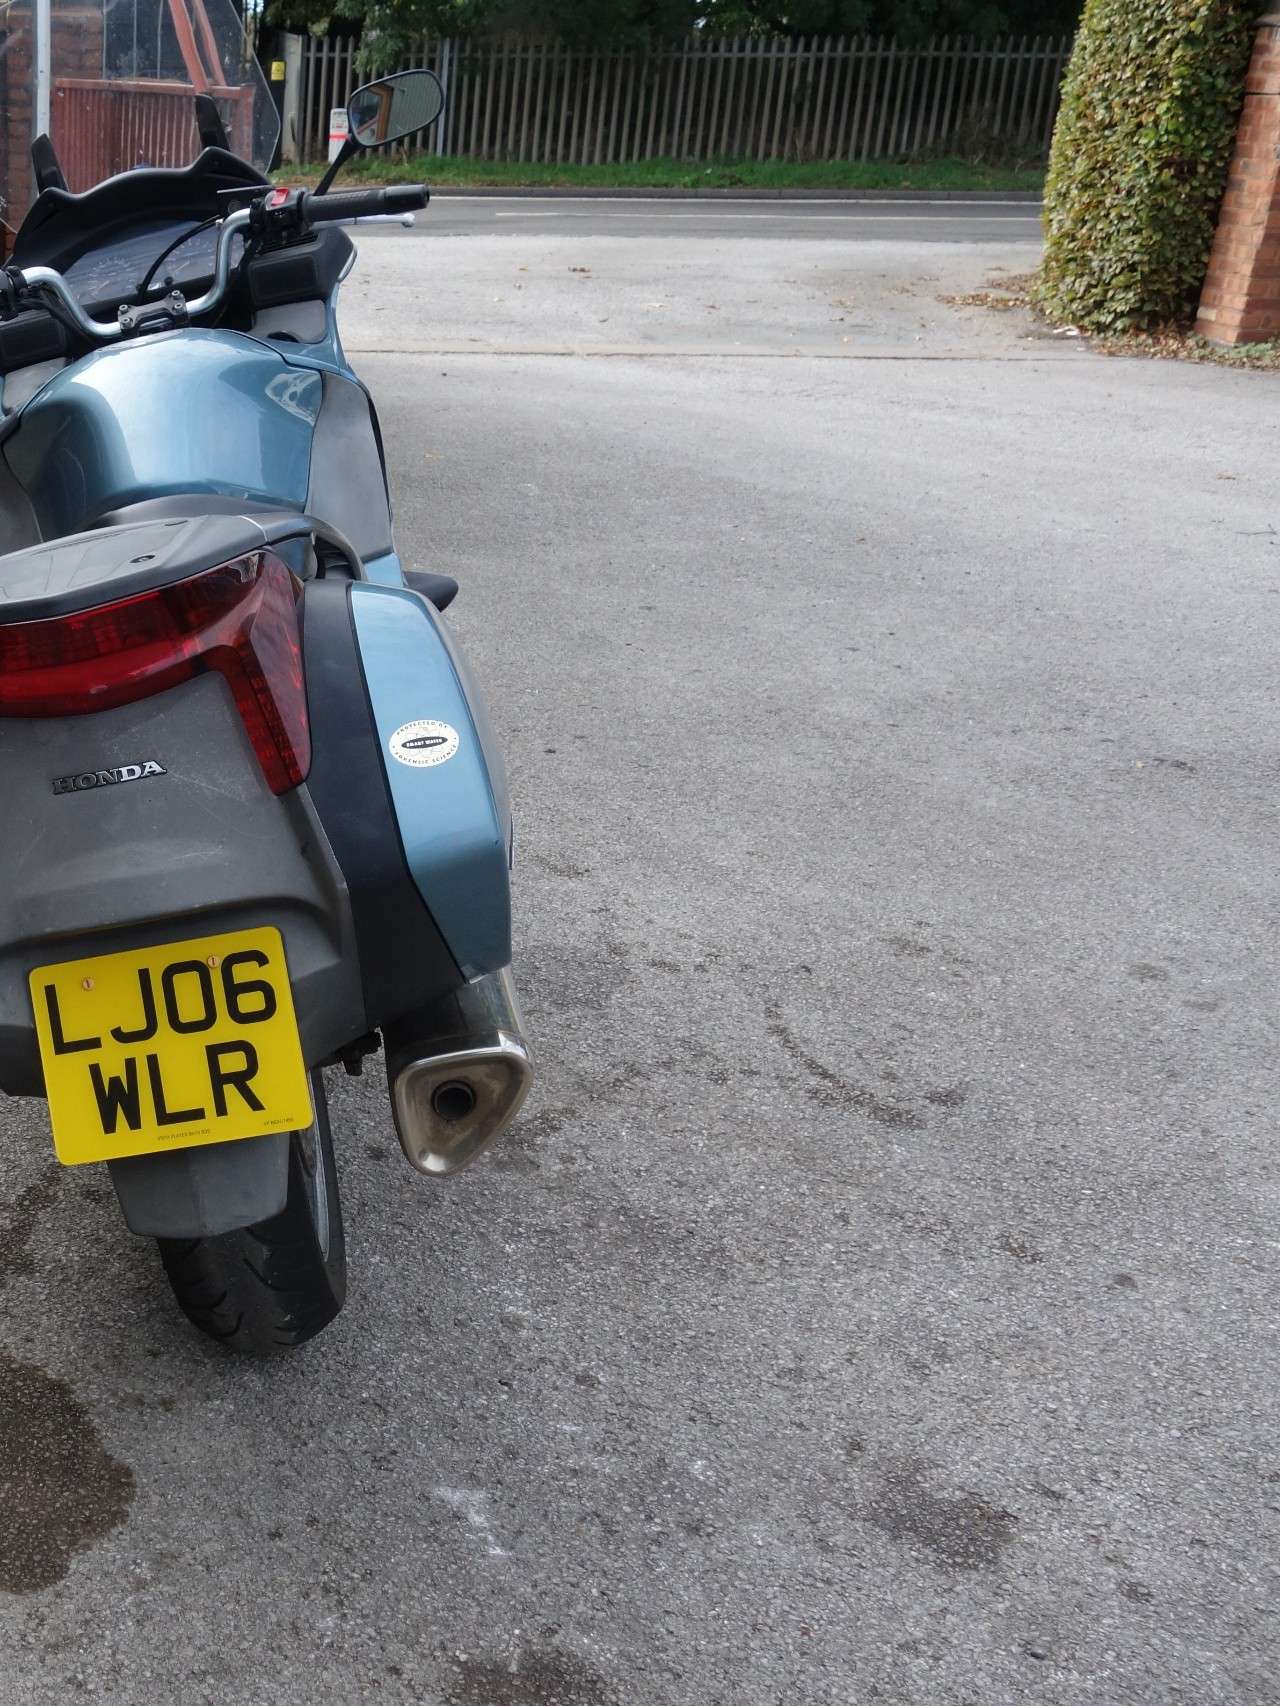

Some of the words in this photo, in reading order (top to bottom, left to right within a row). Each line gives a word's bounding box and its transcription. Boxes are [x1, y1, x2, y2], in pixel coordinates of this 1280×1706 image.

[52, 760, 167, 795] HONDA
[44, 949, 277, 1055] LJ06
[88, 1039, 266, 1134] WLR
